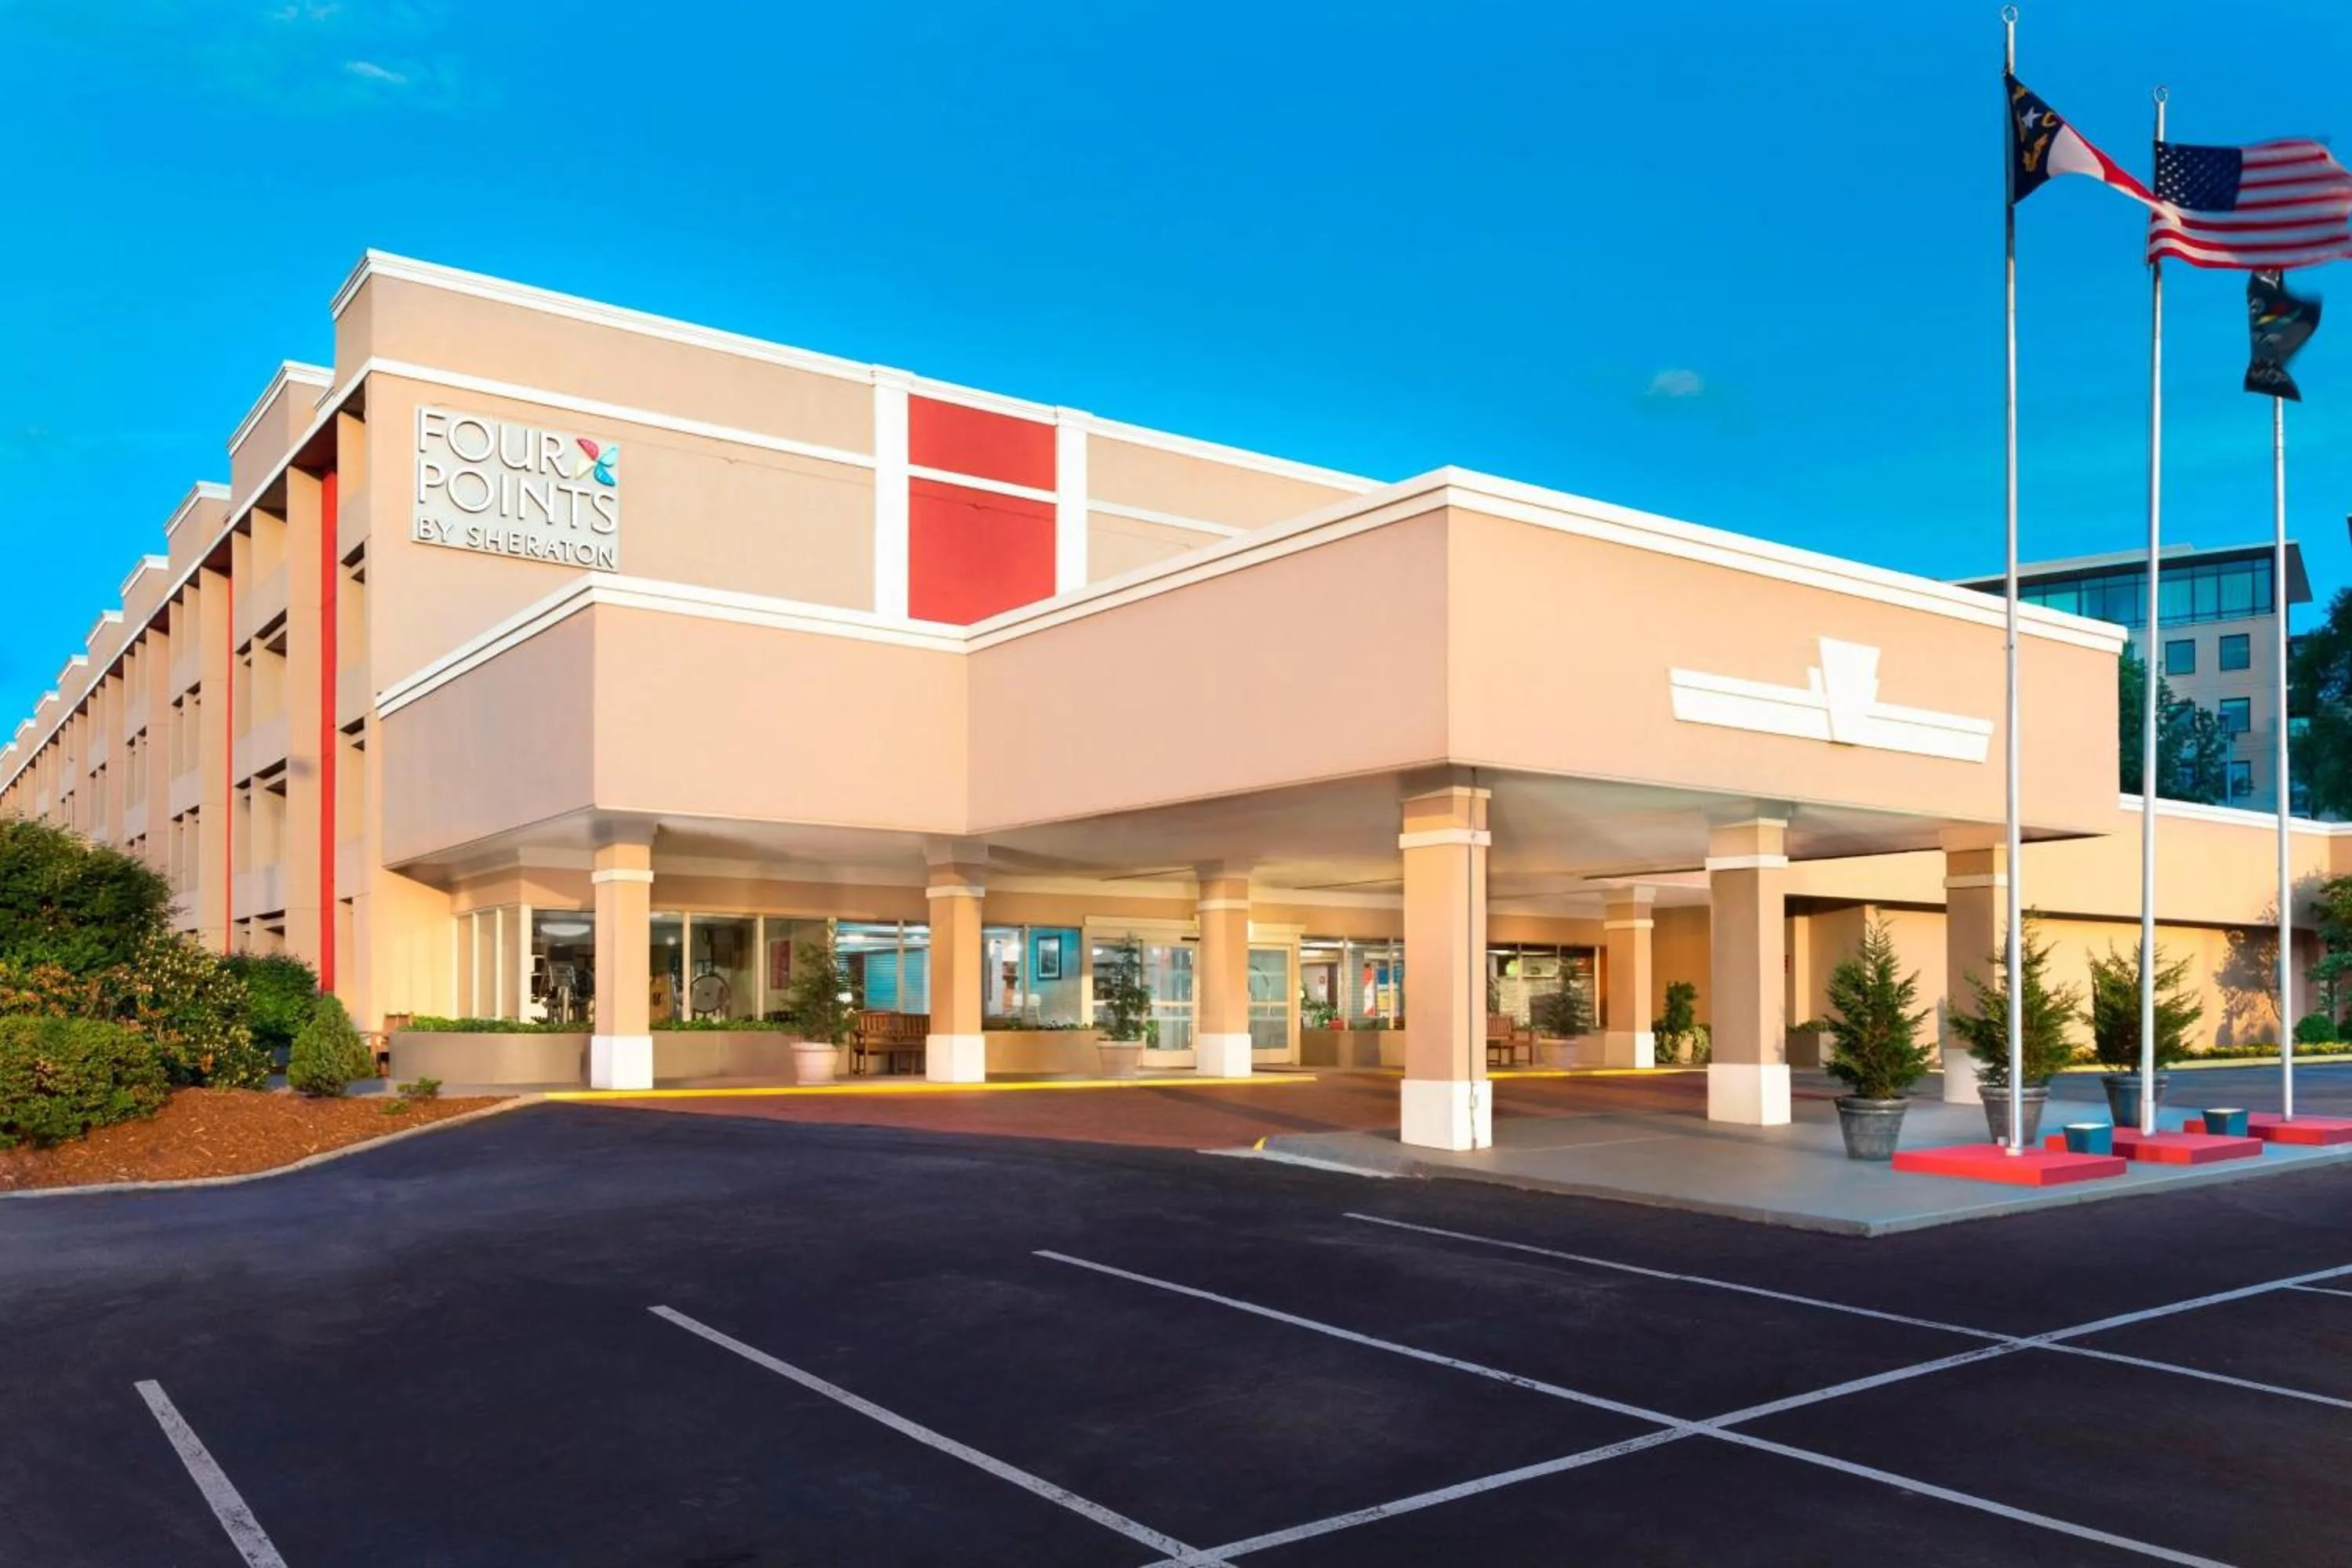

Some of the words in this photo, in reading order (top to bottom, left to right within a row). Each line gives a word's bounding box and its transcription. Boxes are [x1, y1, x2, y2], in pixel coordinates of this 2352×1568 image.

[418, 407, 571, 479] FOUR
[418, 458, 617, 535] POINTS
[418, 516, 453, 543] BY
[466, 526, 615, 569] SHERATON
